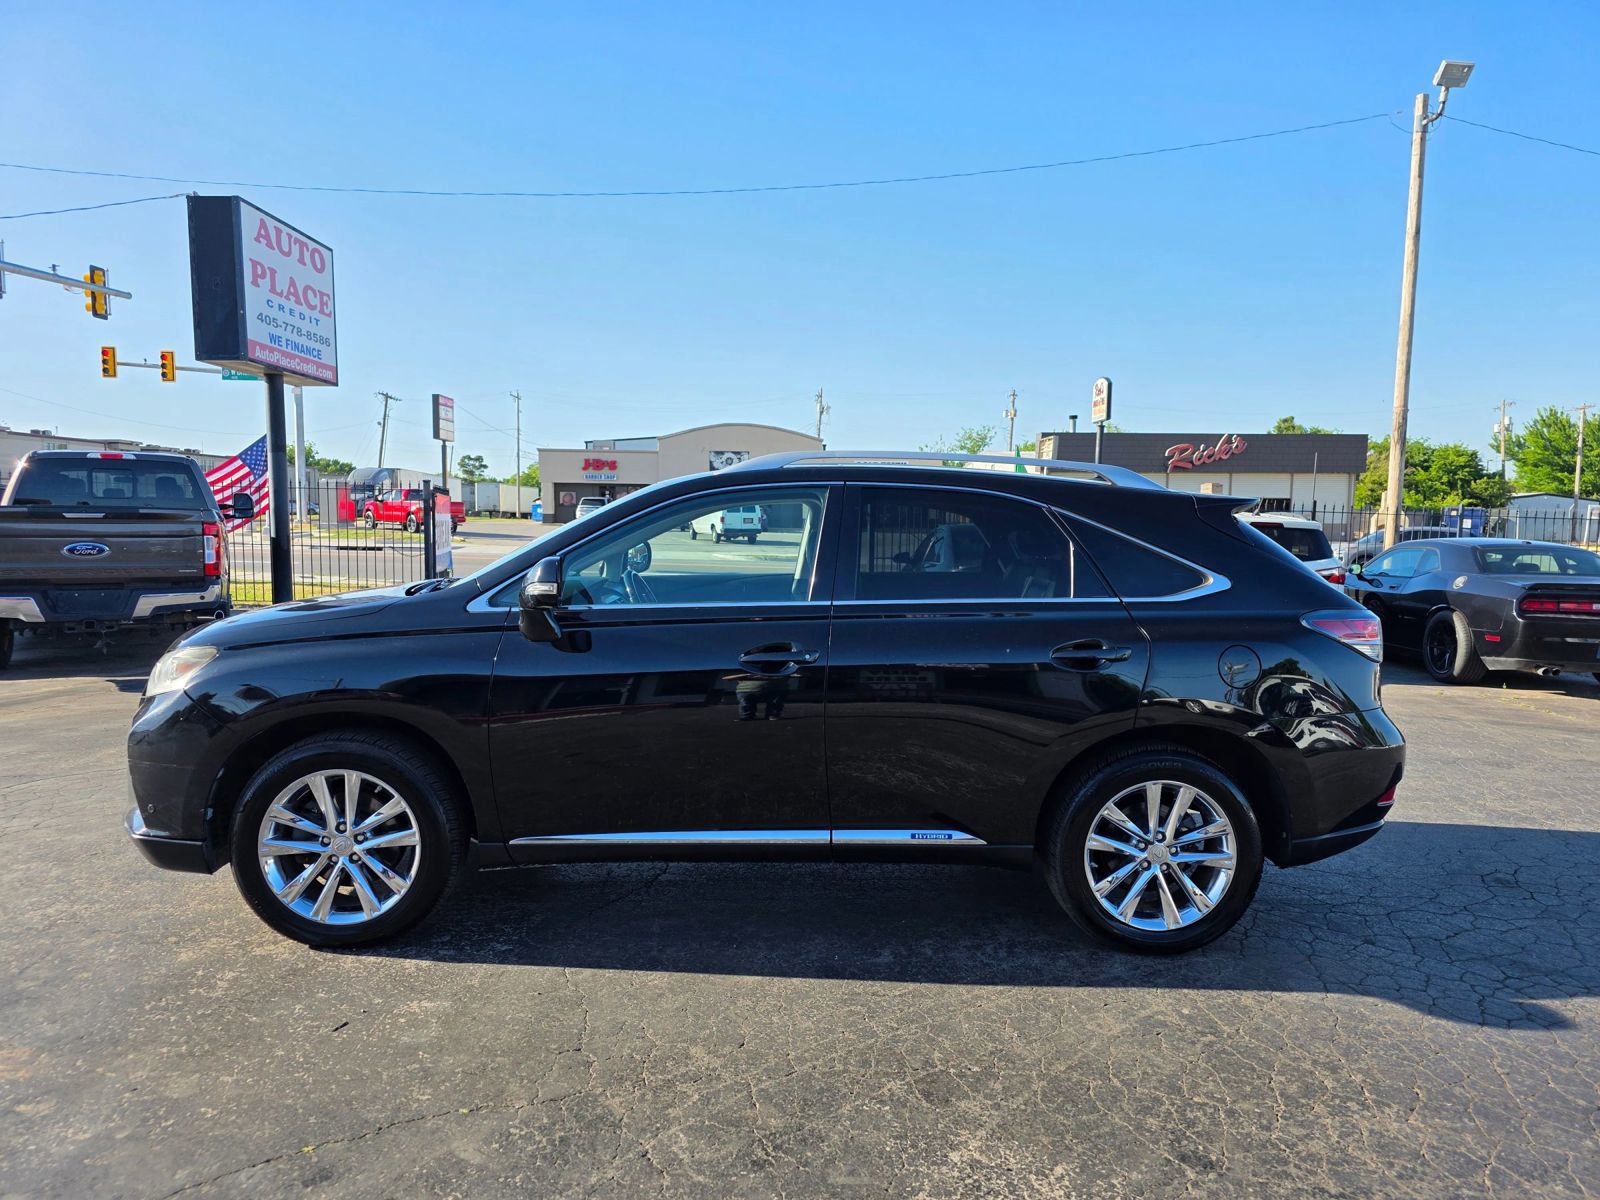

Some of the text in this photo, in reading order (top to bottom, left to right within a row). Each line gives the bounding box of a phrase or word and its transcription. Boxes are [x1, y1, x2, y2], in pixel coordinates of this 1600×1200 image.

[254, 218, 325, 274] AUTO
[249, 258, 332, 318] PLACE
[256, 312, 331, 347] 405-778-8586
[266, 299, 320, 327] CREDIT
[255, 345, 333, 379] AutoPlaceCredit.com
[268, 332, 323, 360] WE FINANCE
[1164, 433, 1248, 473] Rick's
[74, 545, 99, 555] Ford
